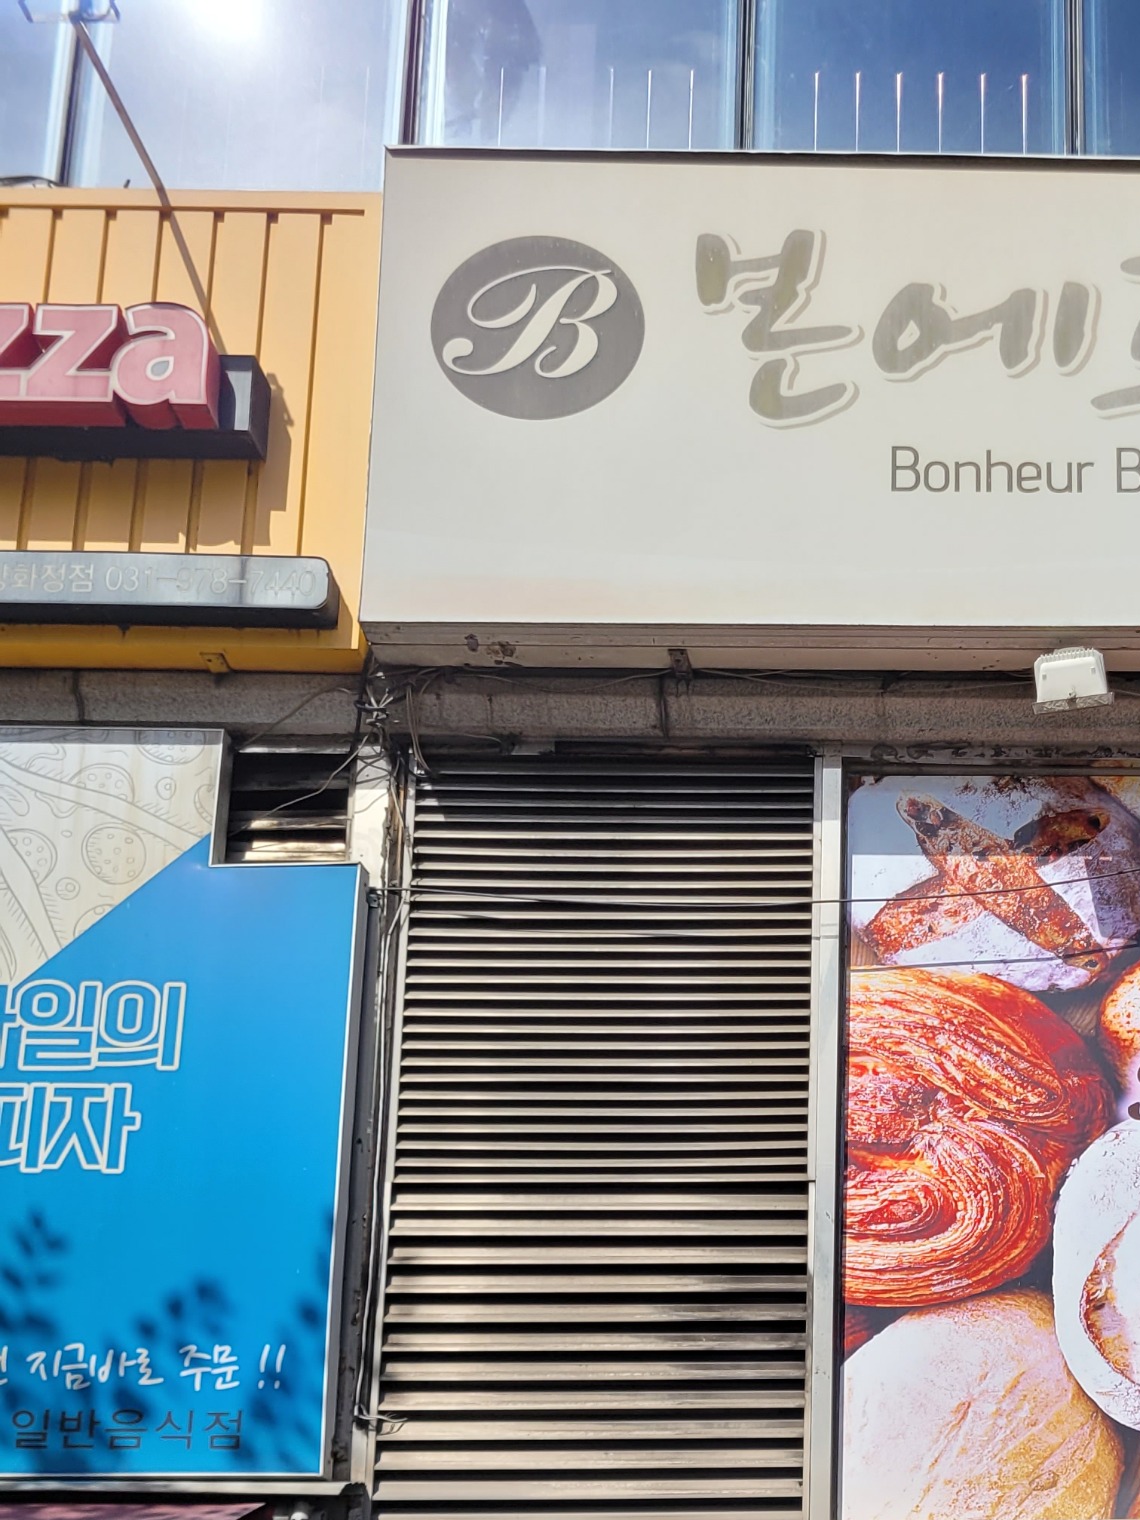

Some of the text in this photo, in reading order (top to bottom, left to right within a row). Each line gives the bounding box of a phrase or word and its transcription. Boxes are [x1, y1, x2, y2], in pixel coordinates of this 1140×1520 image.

[889, 446, 1095, 495] Bonheur
[0, 563, 94, 593] 화정점
[26, 1342, 164, 1390] 지금바로
[179, 1344, 240, 1391] 주문
[11, 1408, 243, 1450] 일반음식점
